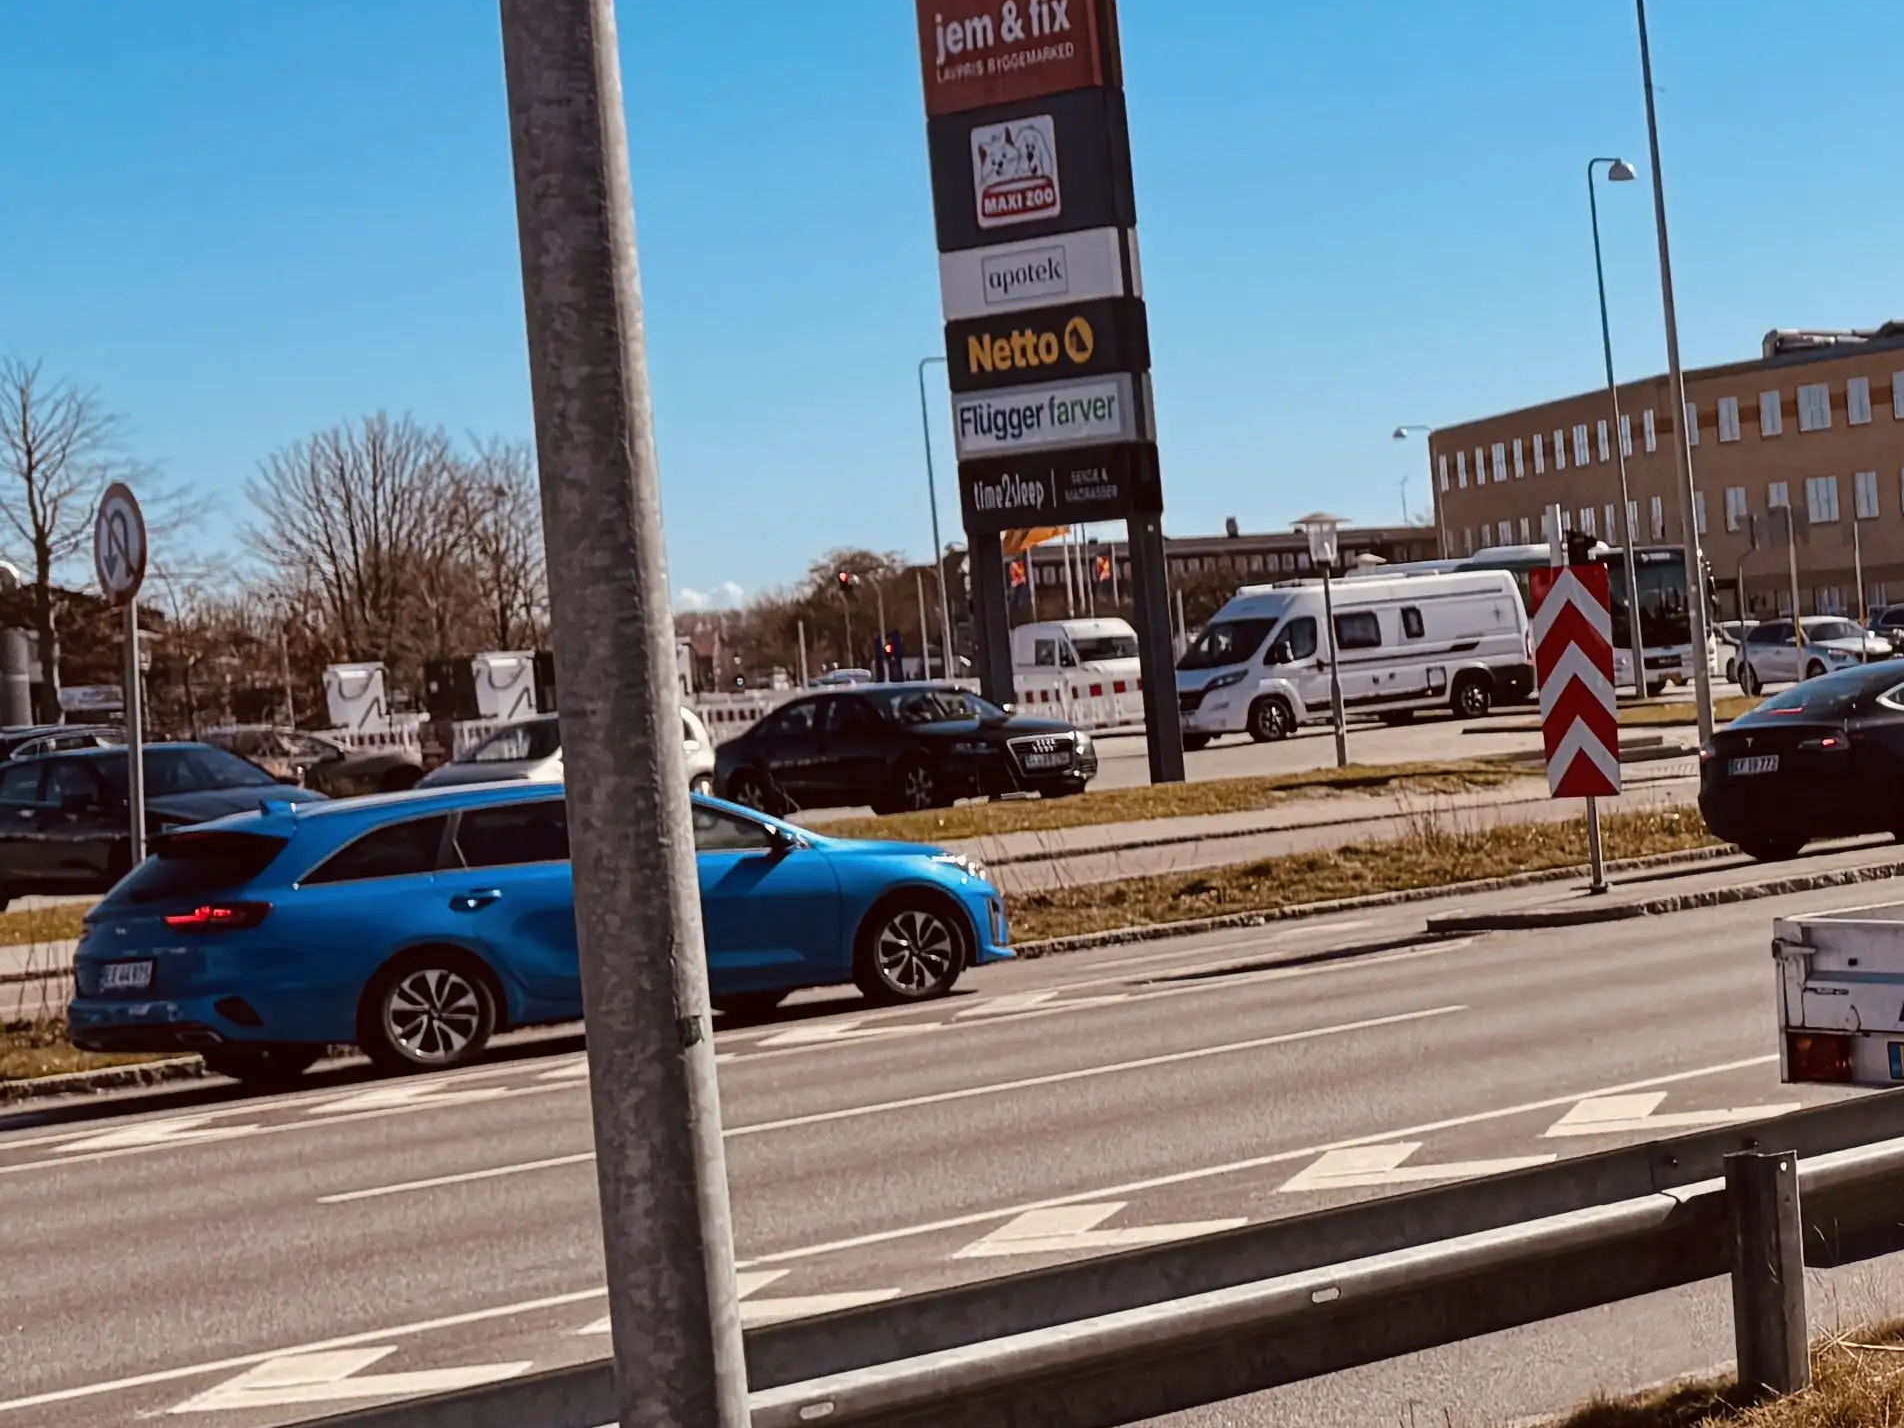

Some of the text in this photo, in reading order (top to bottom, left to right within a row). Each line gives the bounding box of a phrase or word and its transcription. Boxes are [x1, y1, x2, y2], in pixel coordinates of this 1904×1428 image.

[935, 12, 994, 65] jem
[1001, 0, 1026, 41] &
[987, 40, 1075, 74] BYGGEMARKED
[984, 185, 1055, 215] MAXI ZOO
[988, 256, 1063, 294] apotek
[968, 327, 1059, 374] Netto
[960, 393, 1116, 441] Flügger farver
[973, 473, 1045, 511] time2sleep
